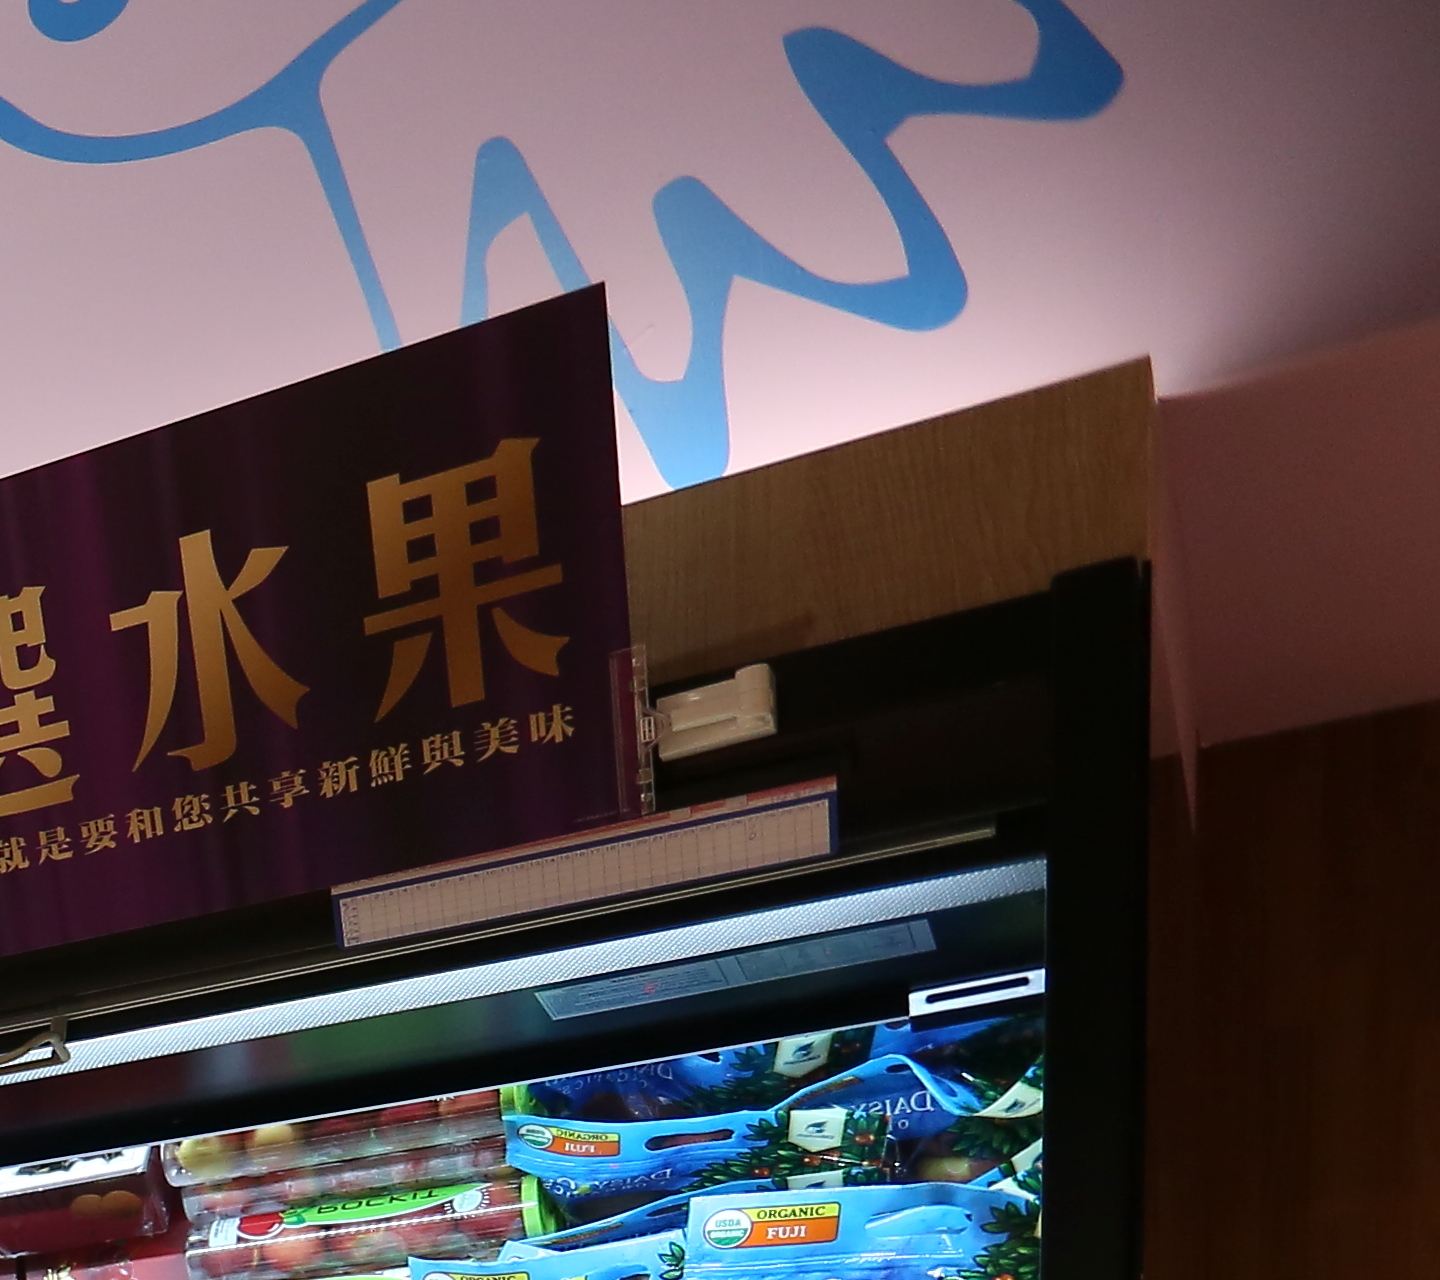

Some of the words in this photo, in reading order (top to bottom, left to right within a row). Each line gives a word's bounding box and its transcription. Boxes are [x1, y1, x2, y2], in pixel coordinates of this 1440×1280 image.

[757, 1207, 827, 1220] ORGANIC
[715, 1218, 743, 1229] USDA
[767, 1226, 807, 1241] FUJI
